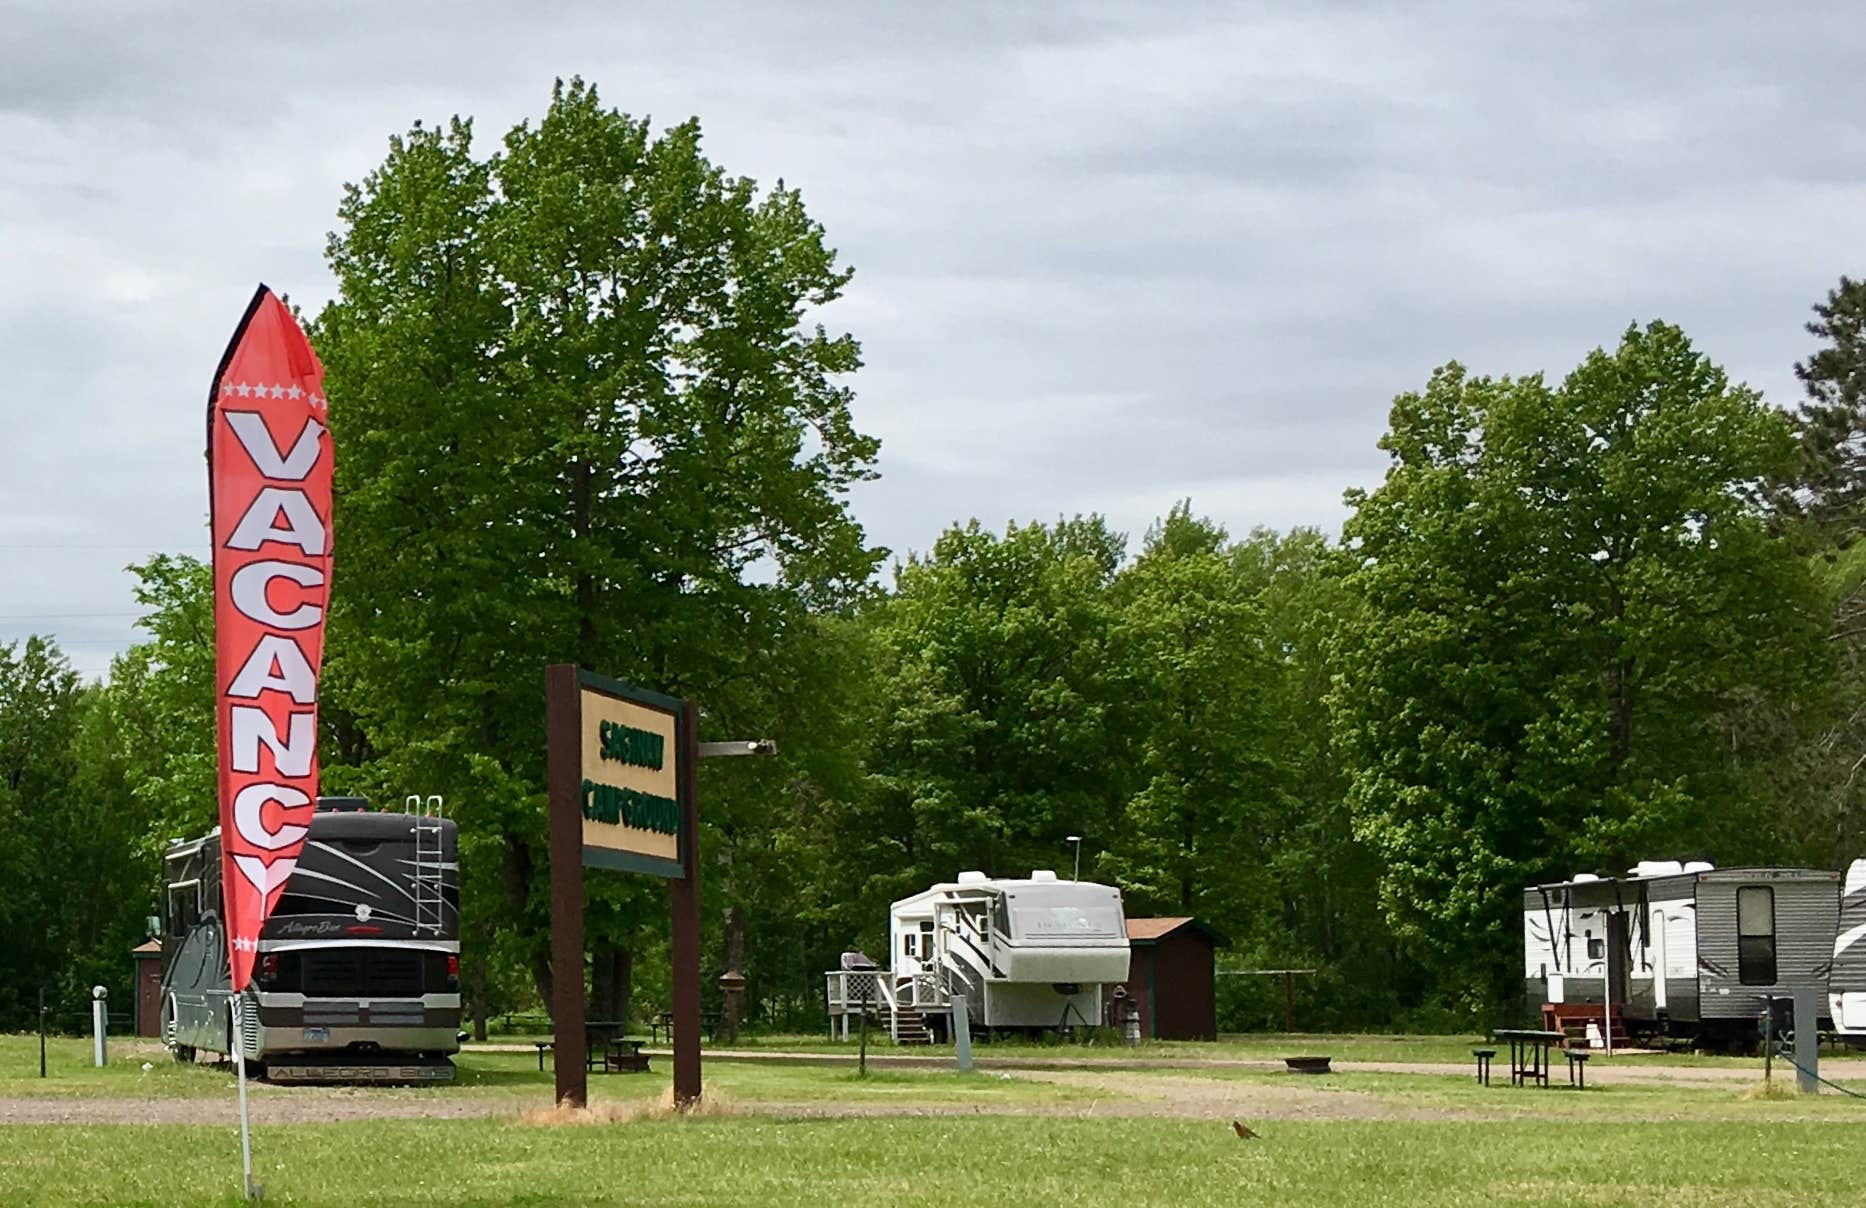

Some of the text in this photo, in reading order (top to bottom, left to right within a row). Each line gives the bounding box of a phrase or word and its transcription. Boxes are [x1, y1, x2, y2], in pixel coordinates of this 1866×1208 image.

[222, 409, 333, 922] VACANCY
[273, 1067, 450, 1079] ALLEGRO BUS
